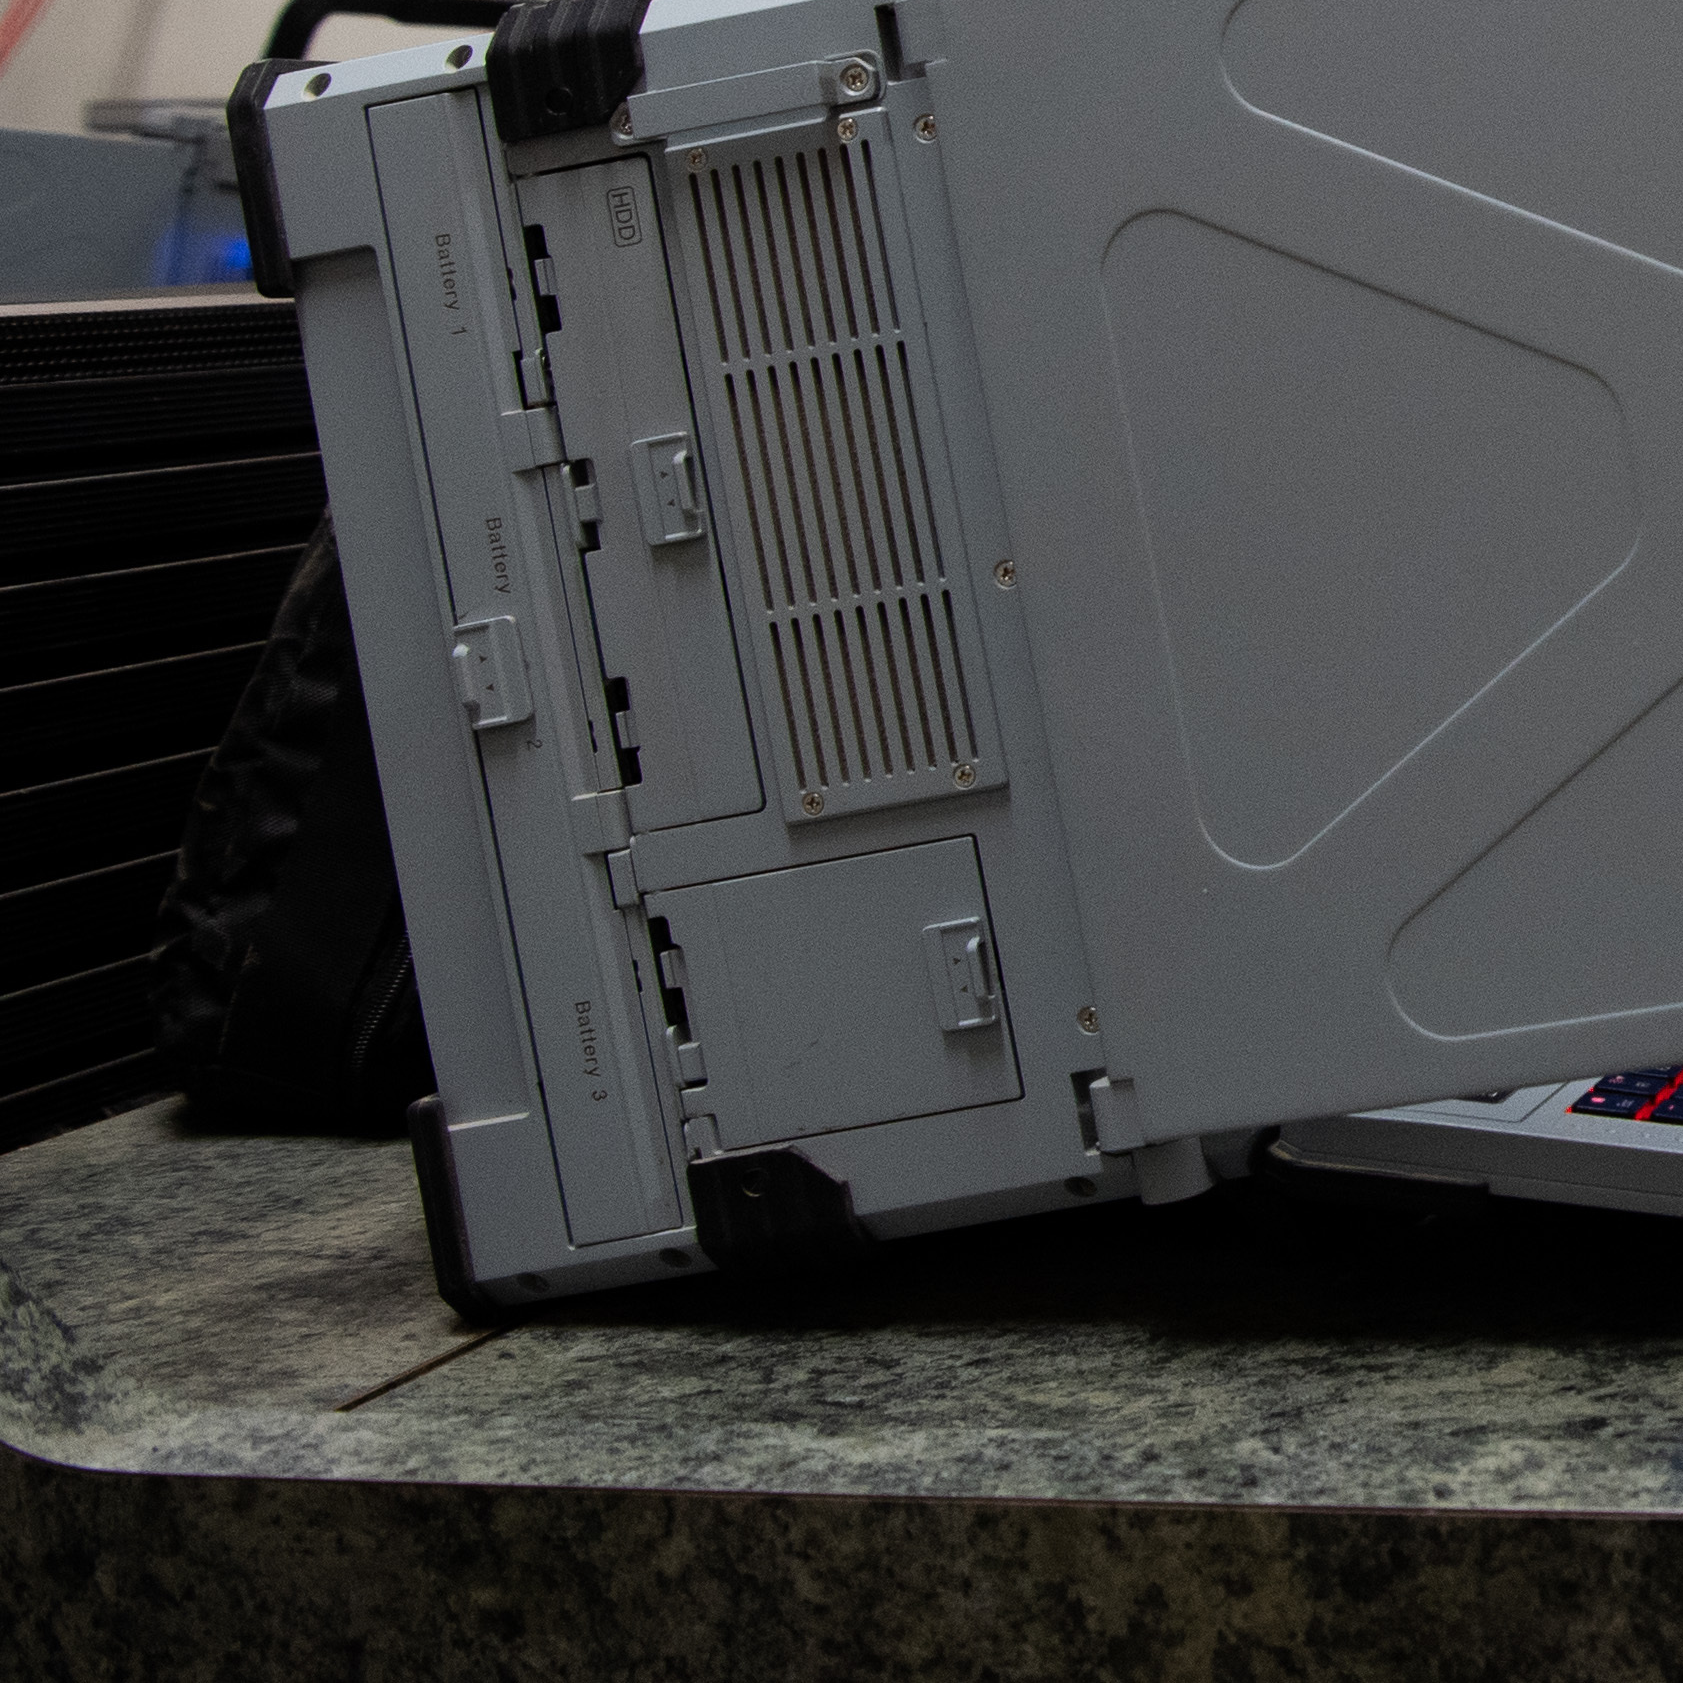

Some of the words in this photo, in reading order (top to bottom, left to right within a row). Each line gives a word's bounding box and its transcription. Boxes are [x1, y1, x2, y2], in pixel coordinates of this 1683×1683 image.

[611, 190, 637, 241] HDD
[435, 233, 460, 311] Battery
[451, 326, 468, 336] 1
[486, 517, 511, 595] Battery
[526, 738, 543, 751] 2
[574, 1000, 601, 1077] Battery
[591, 1089, 608, 1102] 3
